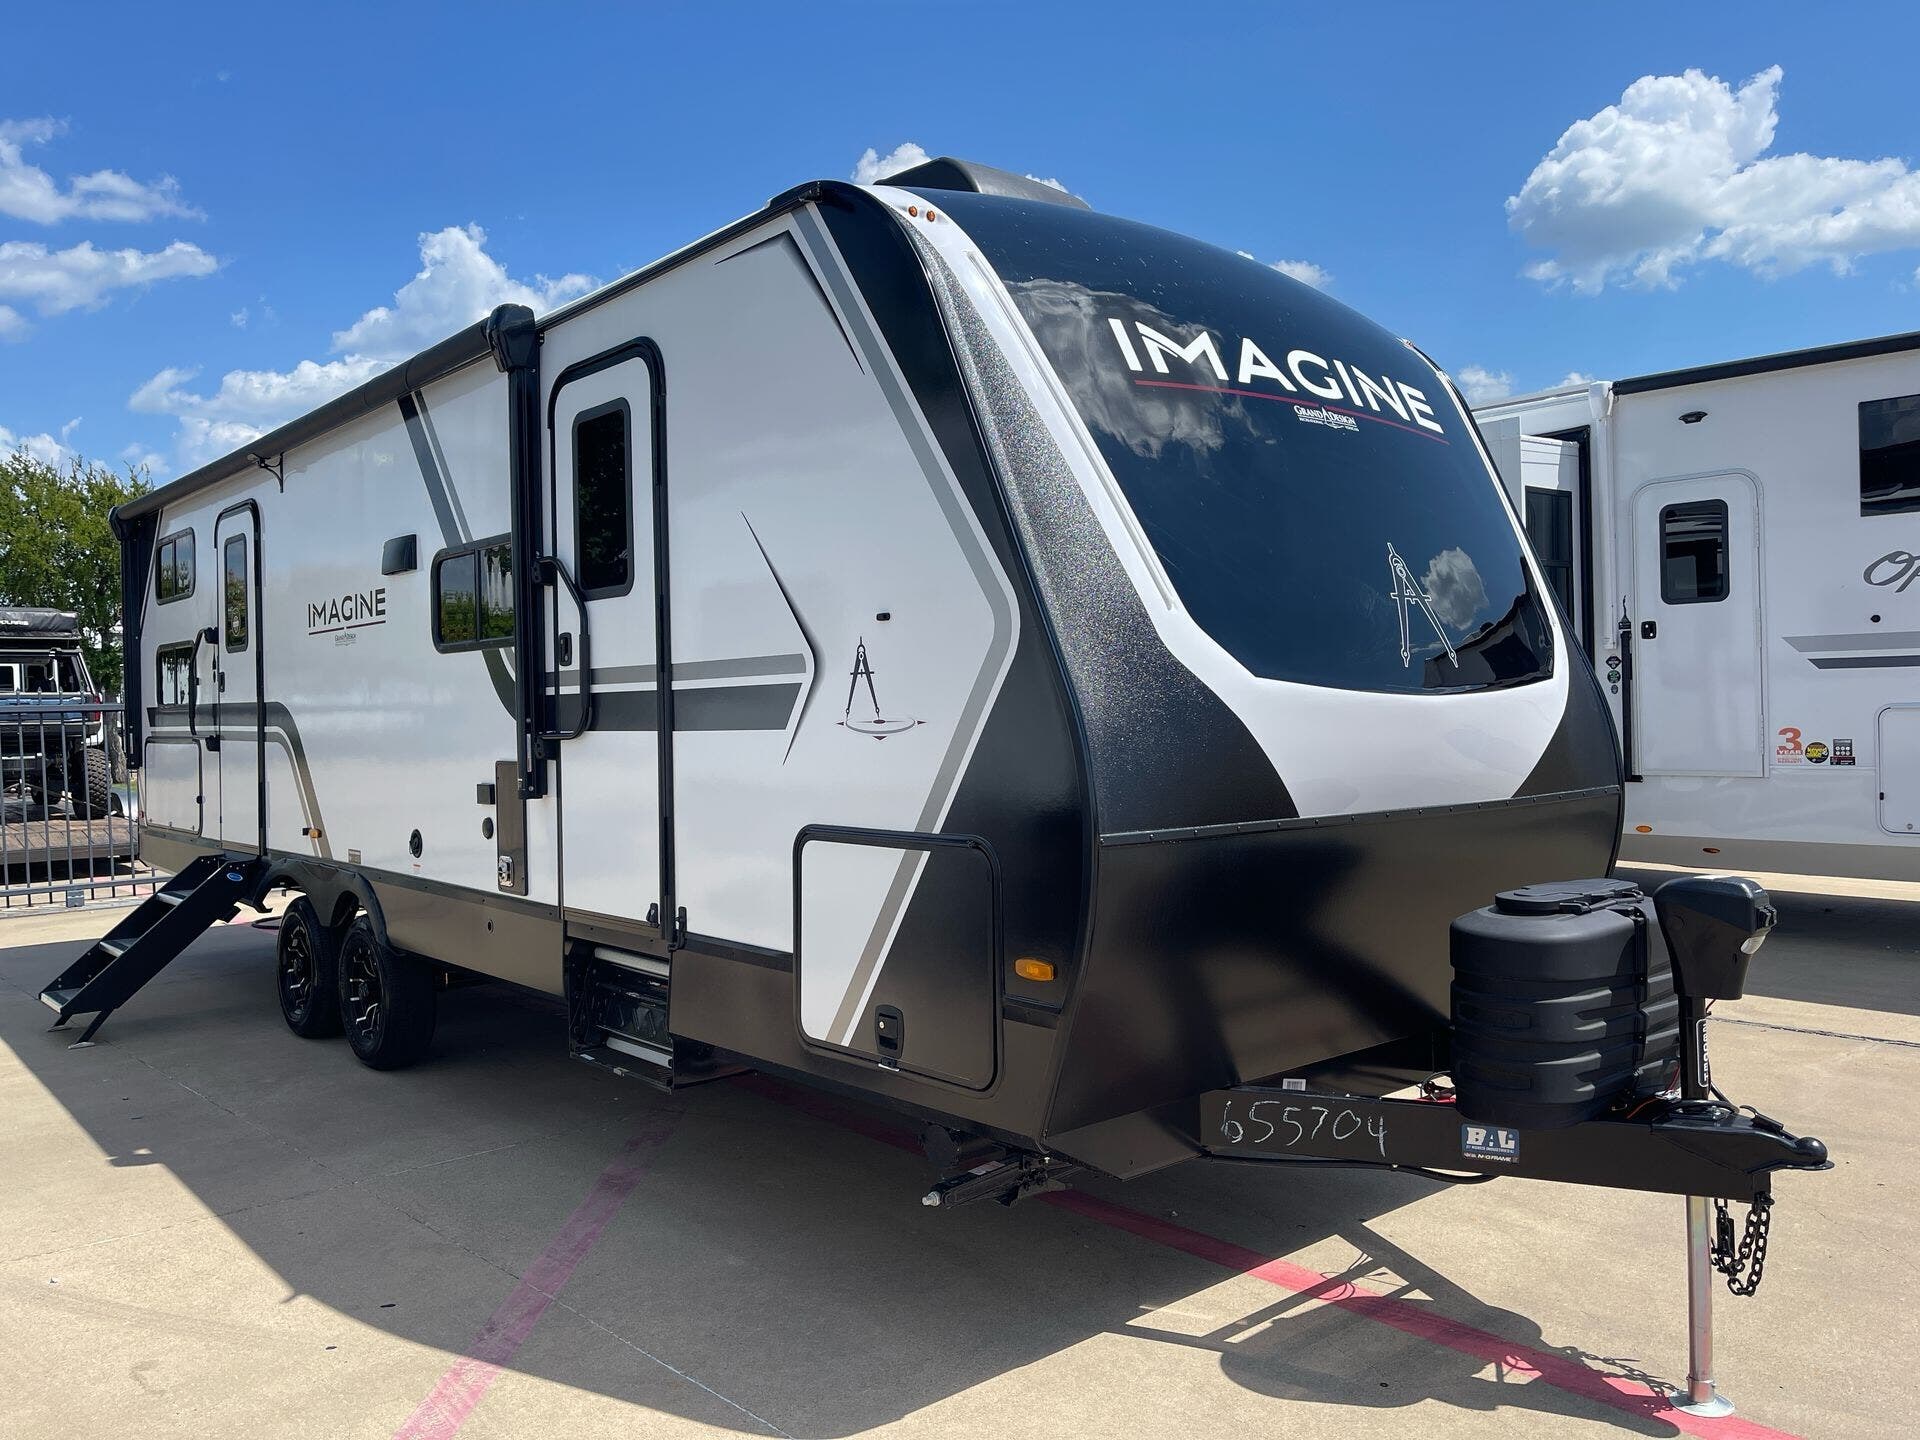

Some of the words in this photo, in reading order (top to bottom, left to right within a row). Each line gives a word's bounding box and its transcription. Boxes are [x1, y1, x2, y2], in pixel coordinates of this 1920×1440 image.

[1107, 317, 1444, 434] IMAGINE
[308, 588, 386, 628] IMAGINE
[1777, 727, 1803, 751] 3
[1220, 1101, 1387, 1157] 655704
